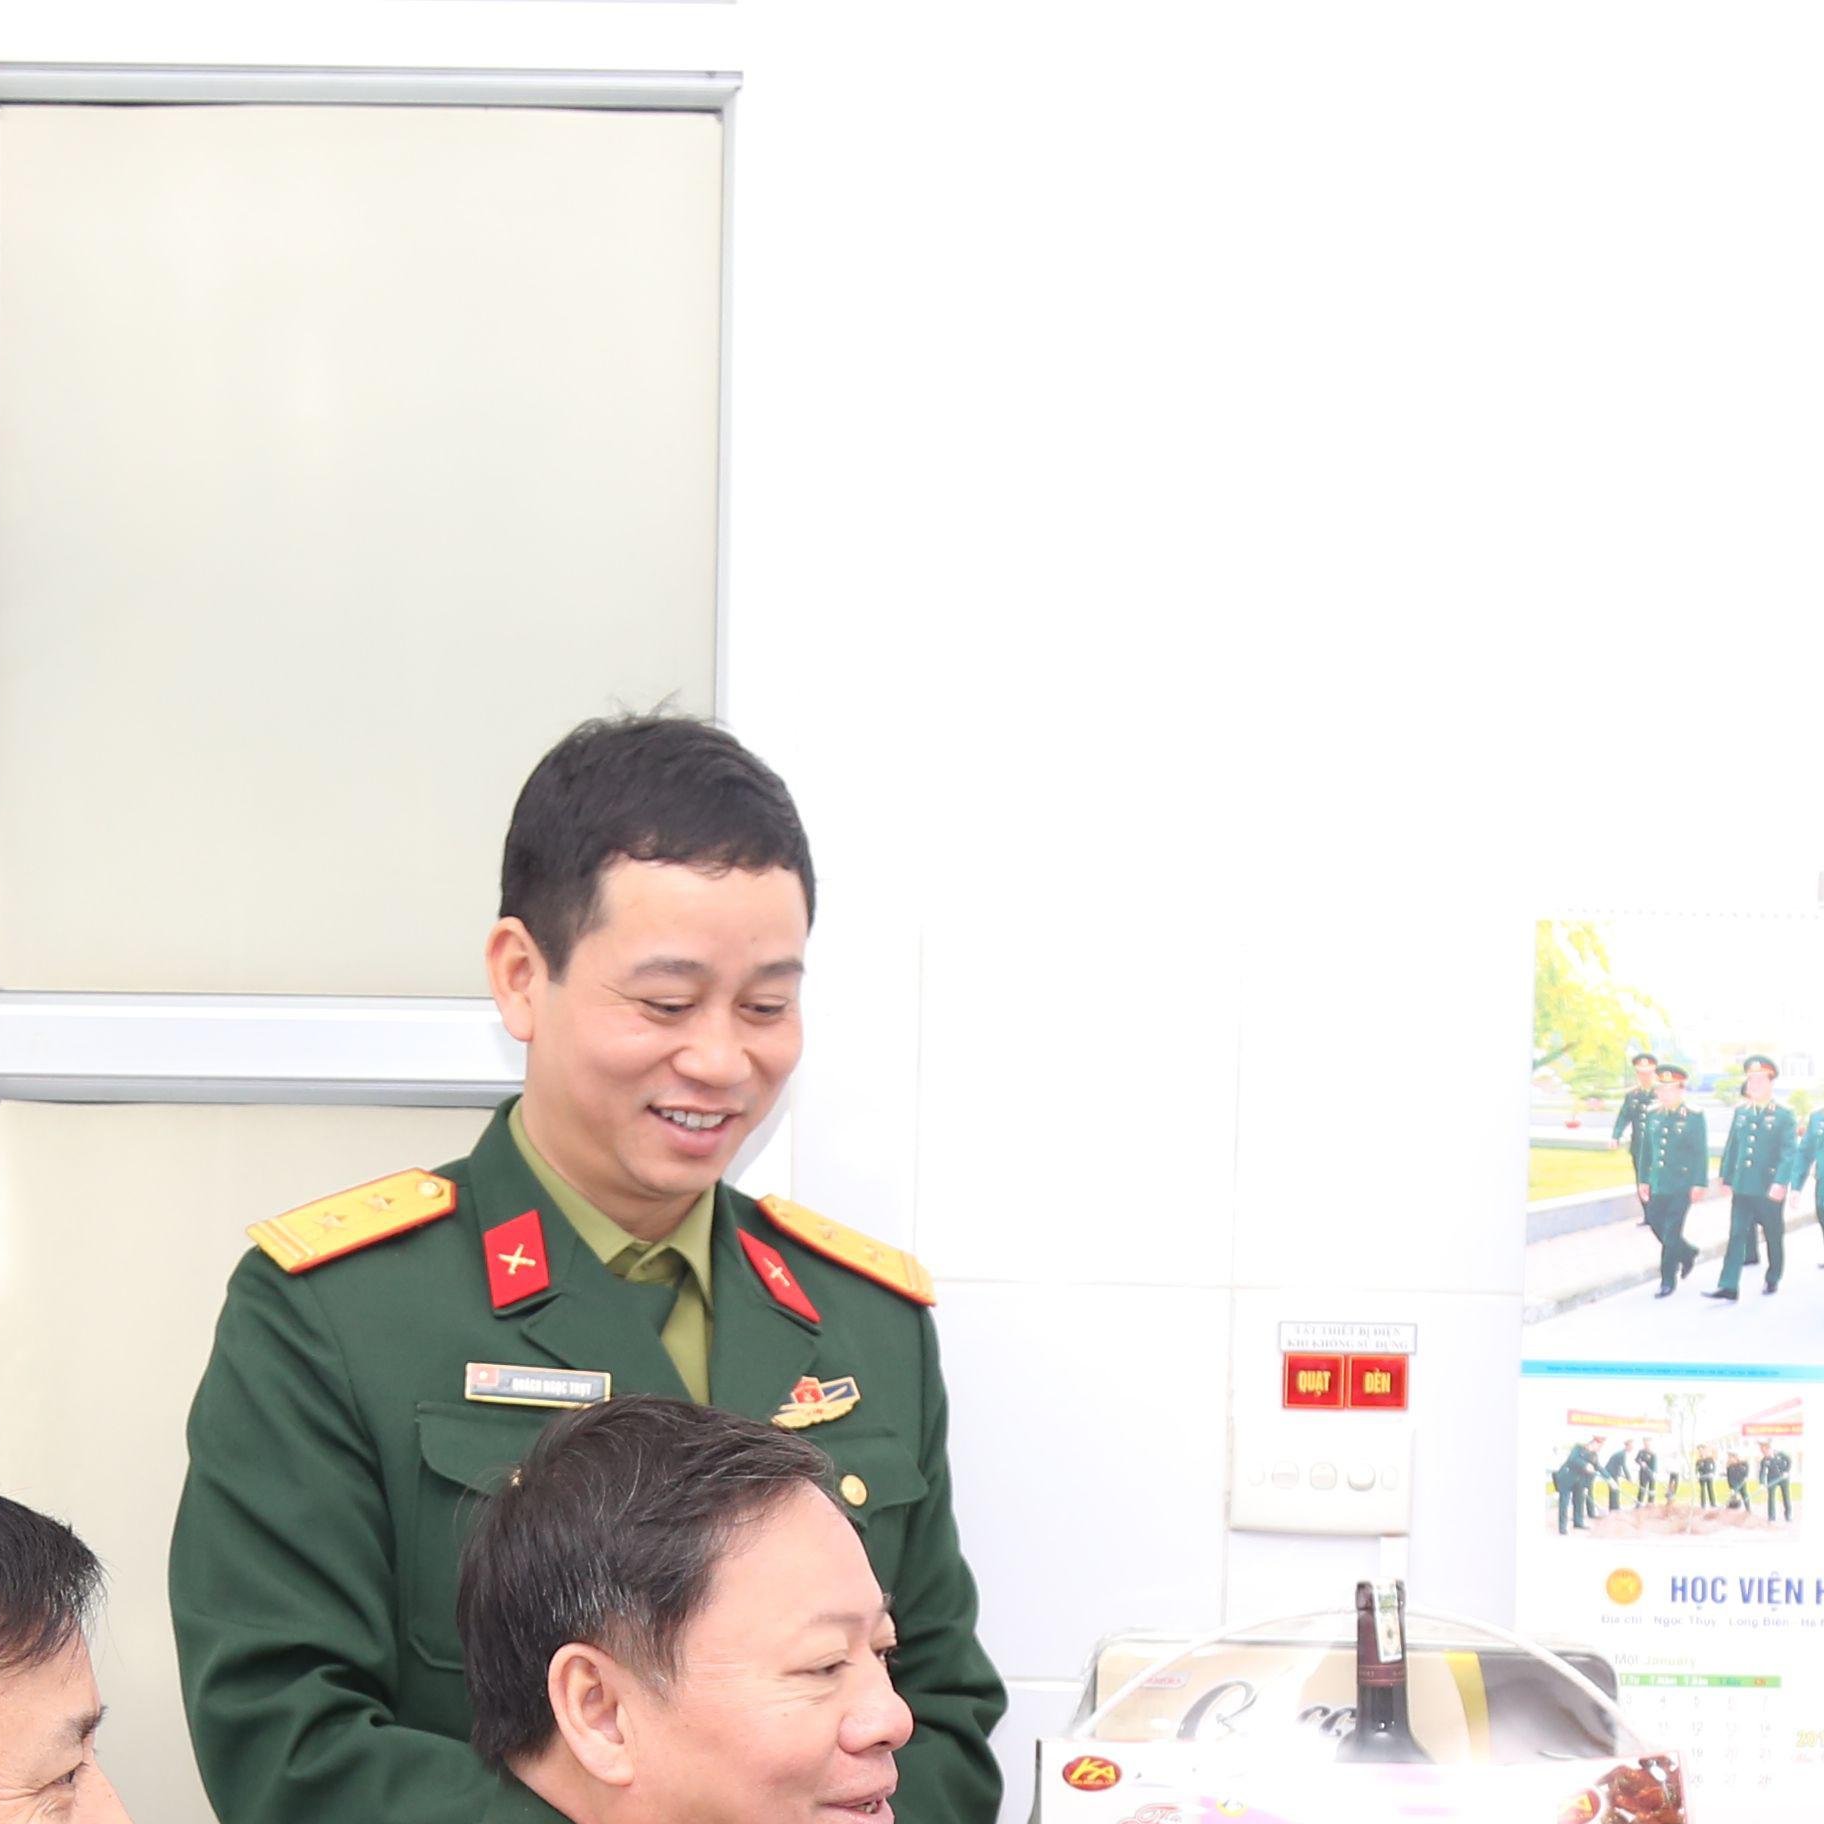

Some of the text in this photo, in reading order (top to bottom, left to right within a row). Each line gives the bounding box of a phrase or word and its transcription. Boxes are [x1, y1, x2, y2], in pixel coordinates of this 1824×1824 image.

[1298, 1370, 1332, 1397] QUẠT
[1670, 1574, 1728, 1611] HỌC
[1739, 1570, 1805, 1612] VIỆN
